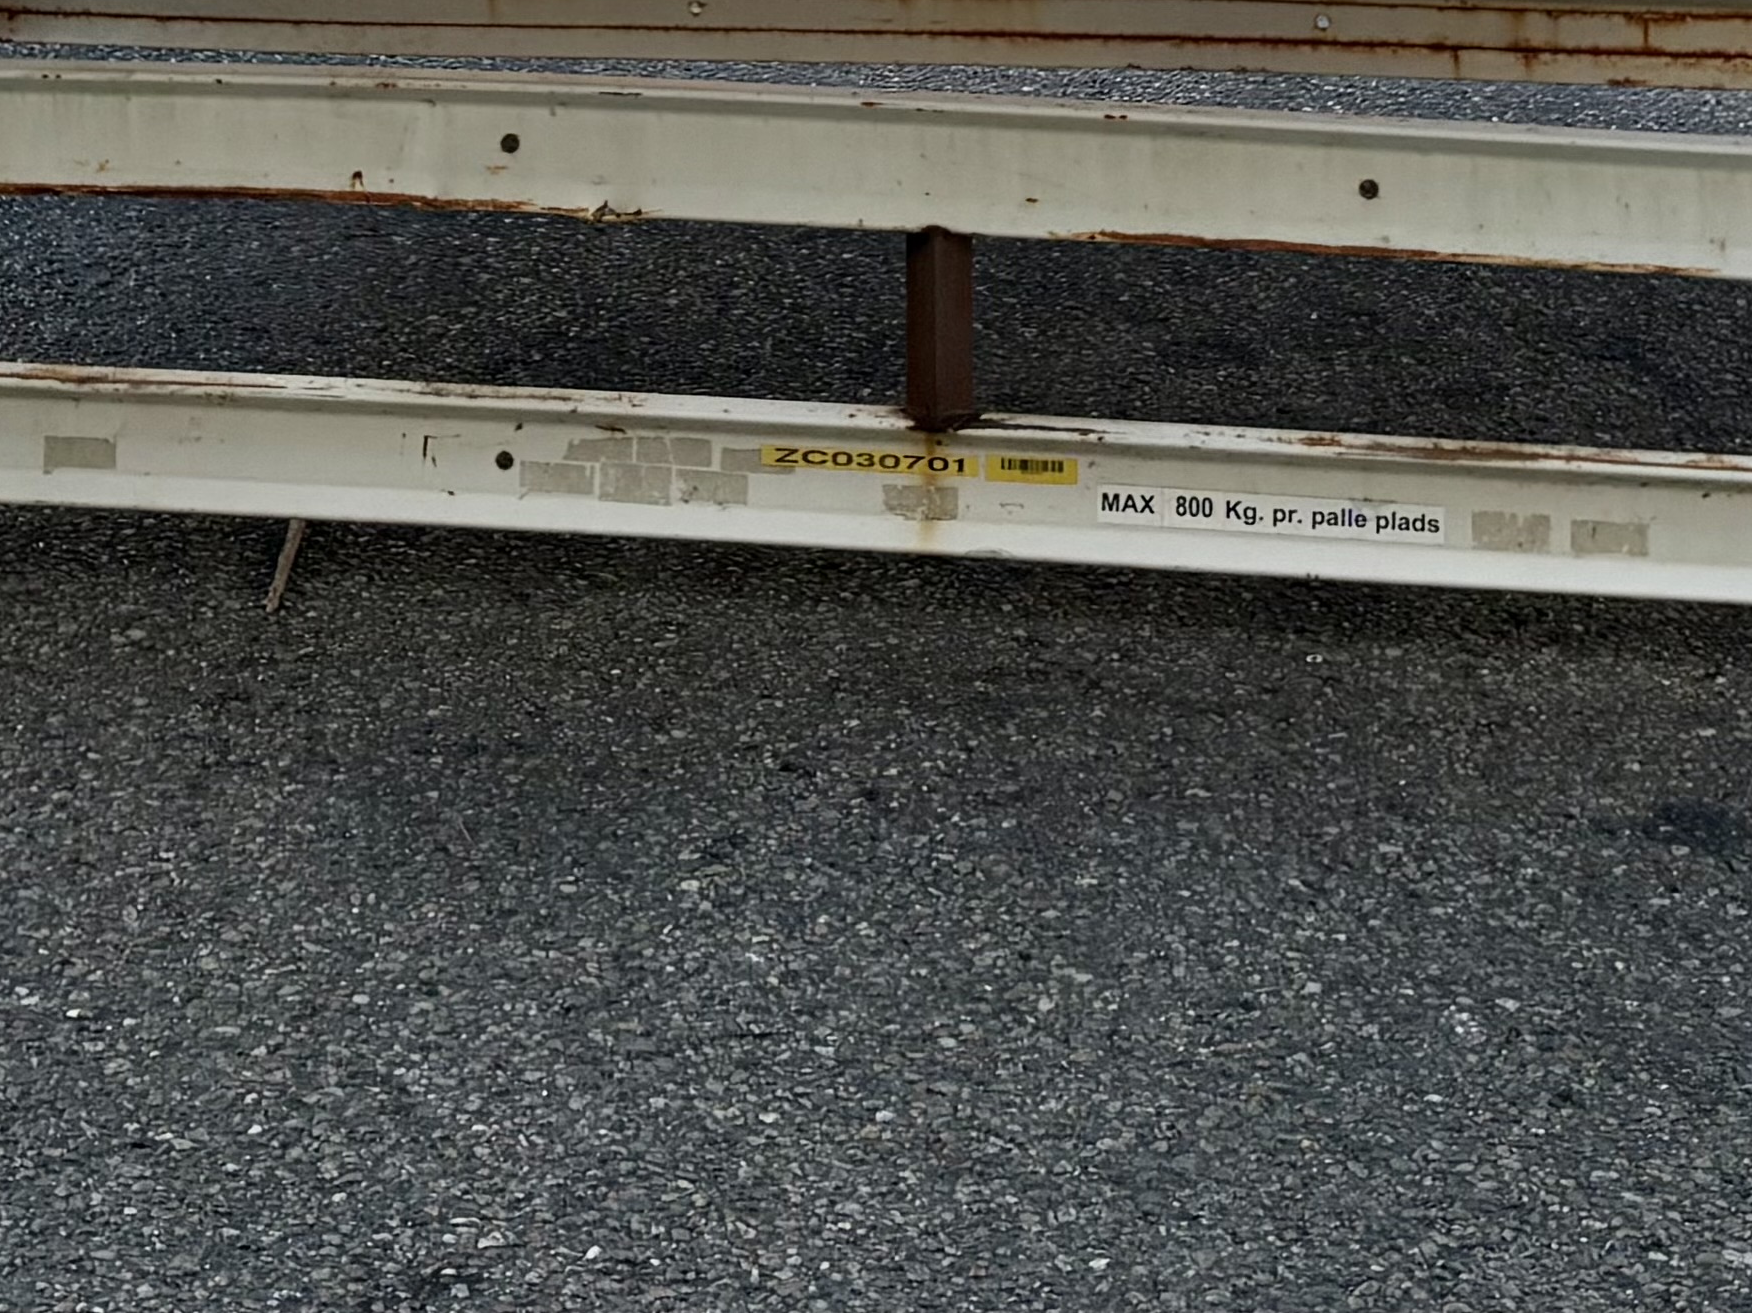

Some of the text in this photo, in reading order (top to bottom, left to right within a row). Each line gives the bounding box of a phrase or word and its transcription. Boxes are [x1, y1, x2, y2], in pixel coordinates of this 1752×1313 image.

[774, 448, 966, 473] ZC030701
[1101, 492, 1440, 534] MAX 800 Kg. pr. palle plads
